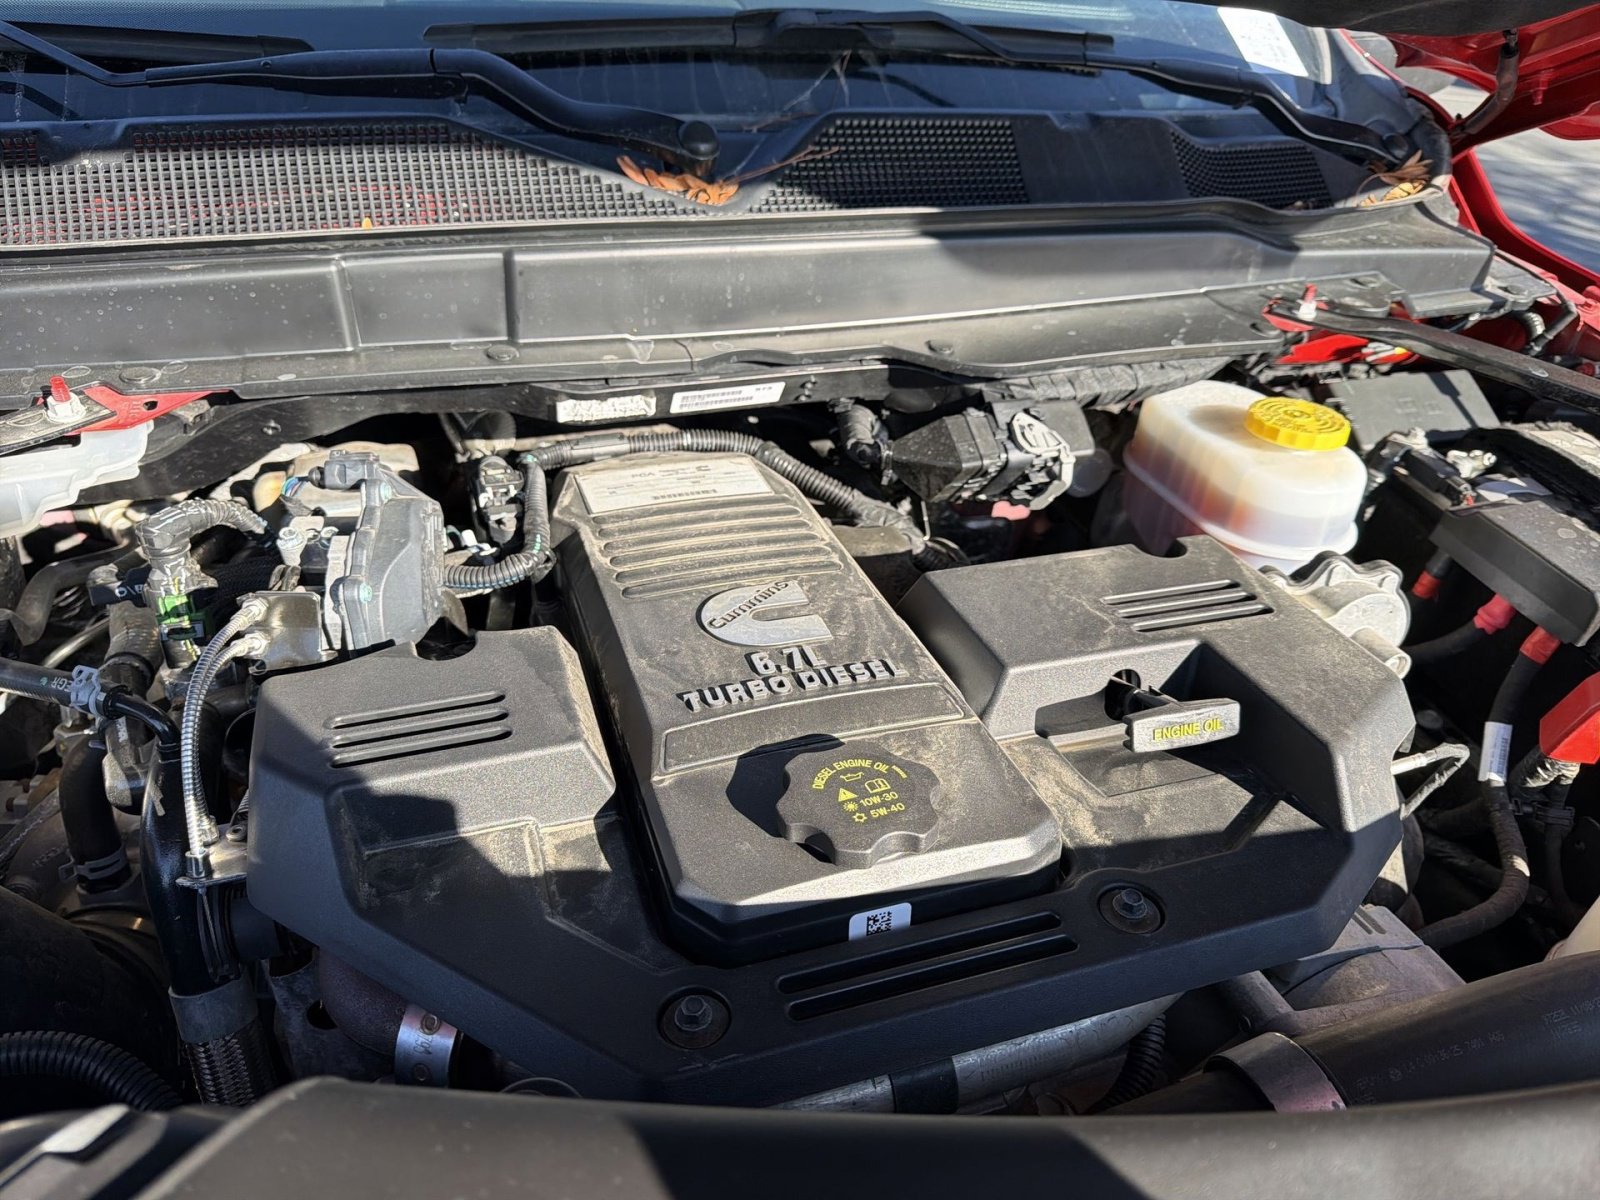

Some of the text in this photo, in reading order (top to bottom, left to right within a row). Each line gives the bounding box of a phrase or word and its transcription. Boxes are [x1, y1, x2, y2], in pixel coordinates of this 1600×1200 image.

[707, 580, 789, 630] Cummins
[745, 644, 828, 677] 6.7L
[677, 657, 909, 712] TURBO DIESEL
[1153, 717, 1224, 740] ENGINE OIL
[812, 767, 837, 789] DIESEL
[833, 759, 873, 771] ENGINE
[873, 762, 889, 774] OIL
[859, 791, 899, 807] 10W-30
[869, 802, 906, 818] 5W-40
